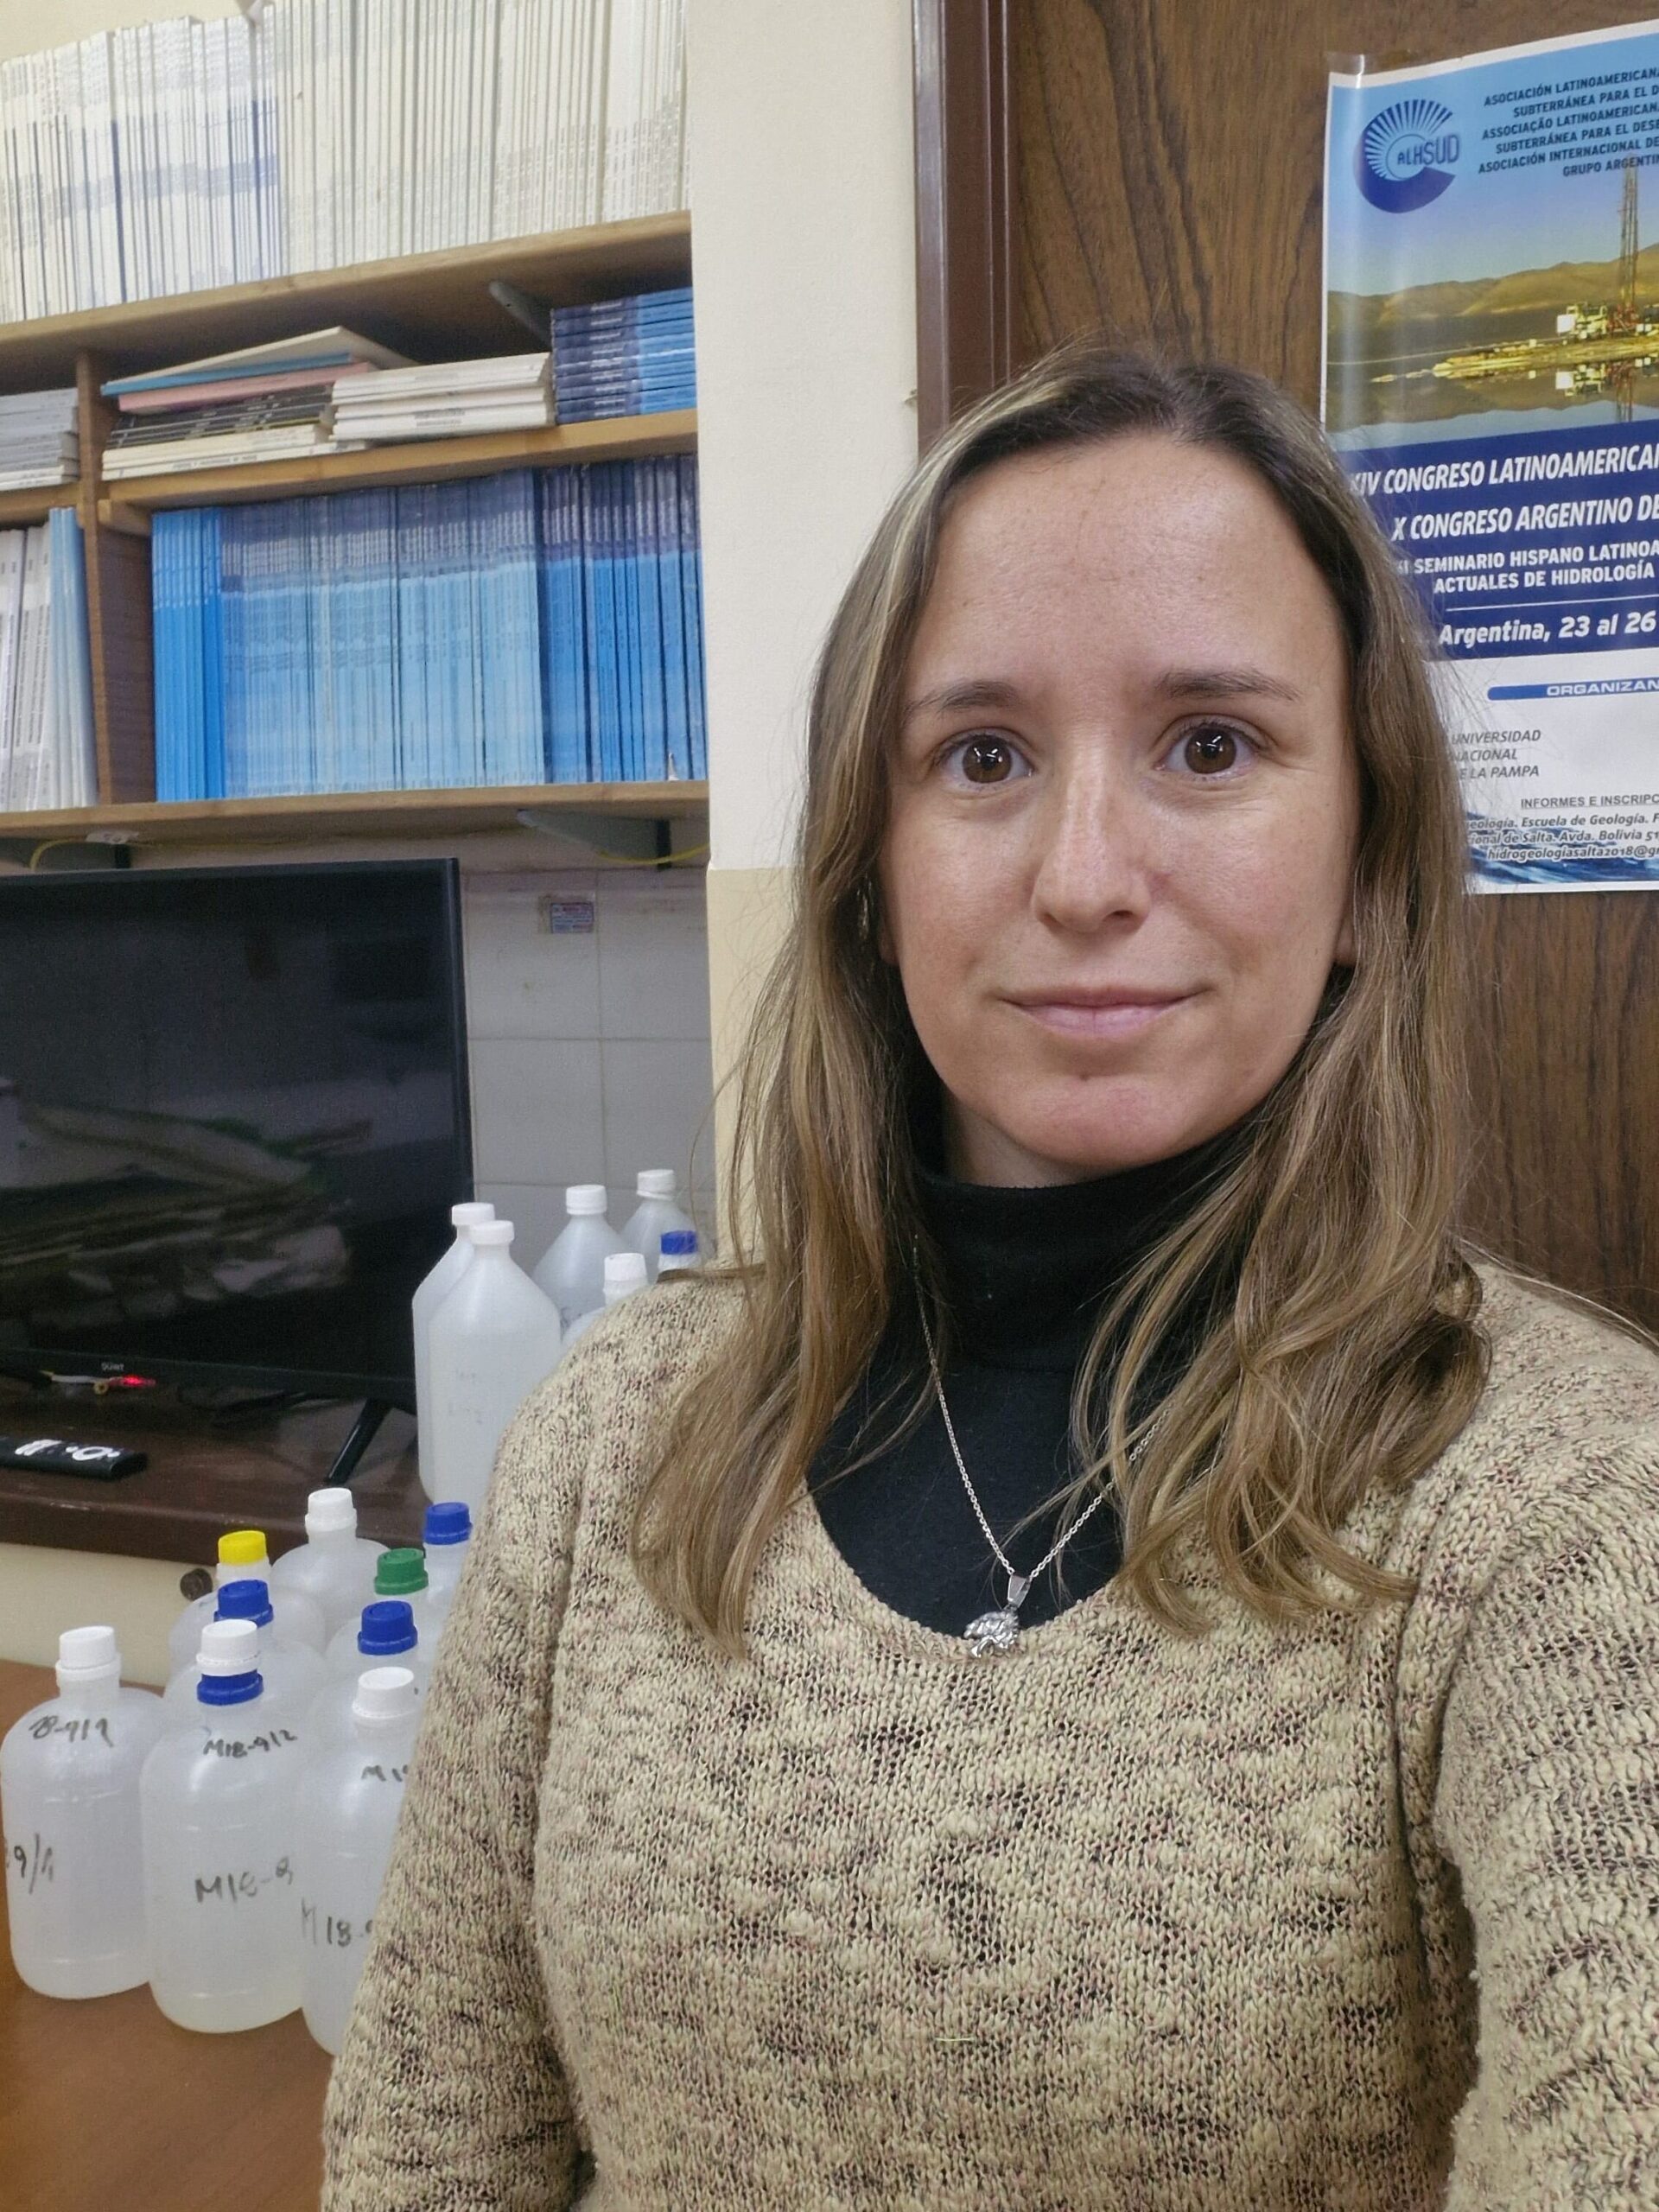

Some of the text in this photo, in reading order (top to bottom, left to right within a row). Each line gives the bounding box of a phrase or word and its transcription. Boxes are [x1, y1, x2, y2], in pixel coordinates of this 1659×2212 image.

[1484, 67, 1659, 106] ASOCIACIÓN LATINOAMERICAN
[1514, 94, 1595, 118] SUBTERRÁNEA
[1599, 87, 1630, 105] PARA
[1635, 86, 1649, 99] EL
[1482, 101, 1659, 140] ASSOCIAÇÃO LATINOAMERICAN
[1496, 131, 1577, 154] SUBTERRÁNEA
[1581, 125, 1611, 144] PARA
[1615, 124, 1630, 135] EL
[1478, 149, 1546, 174] ASOCIACIÓN
[1549, 139, 1642, 162] INTERNACIONAL
[1562, 161, 1601, 177] GRUPO
[1383, 461, 1485, 494] CONGRESO
[1391, 493, 1659, 542] X CONGRESO ARGENTINO DE
[1414, 552, 1505, 575] SEMINARIO
[1510, 546, 1584, 567] HISPANO
[1433, 559, 1655, 594] ACTUALES DE HIDROLOGÍA
[1439, 610, 1656, 649] Argentina, 23 al 26
[1452, 729, 1541, 745] UNIVERSIDAD
[1470, 767, 1486, 779] LA
[1491, 765, 1540, 779] PAMPA
[1521, 796, 1585, 808] INFORMES
[1590, 796, 1598, 806] E
[1522, 815, 1567, 829] Escuela
[1570, 814, 1586, 826] de
[1590, 812, 1649, 827] Geología.
[1503, 832, 1519, 844] de
[1559, 830, 1595, 842] Avda.
[1599, 829, 1643, 842] Bolivia
